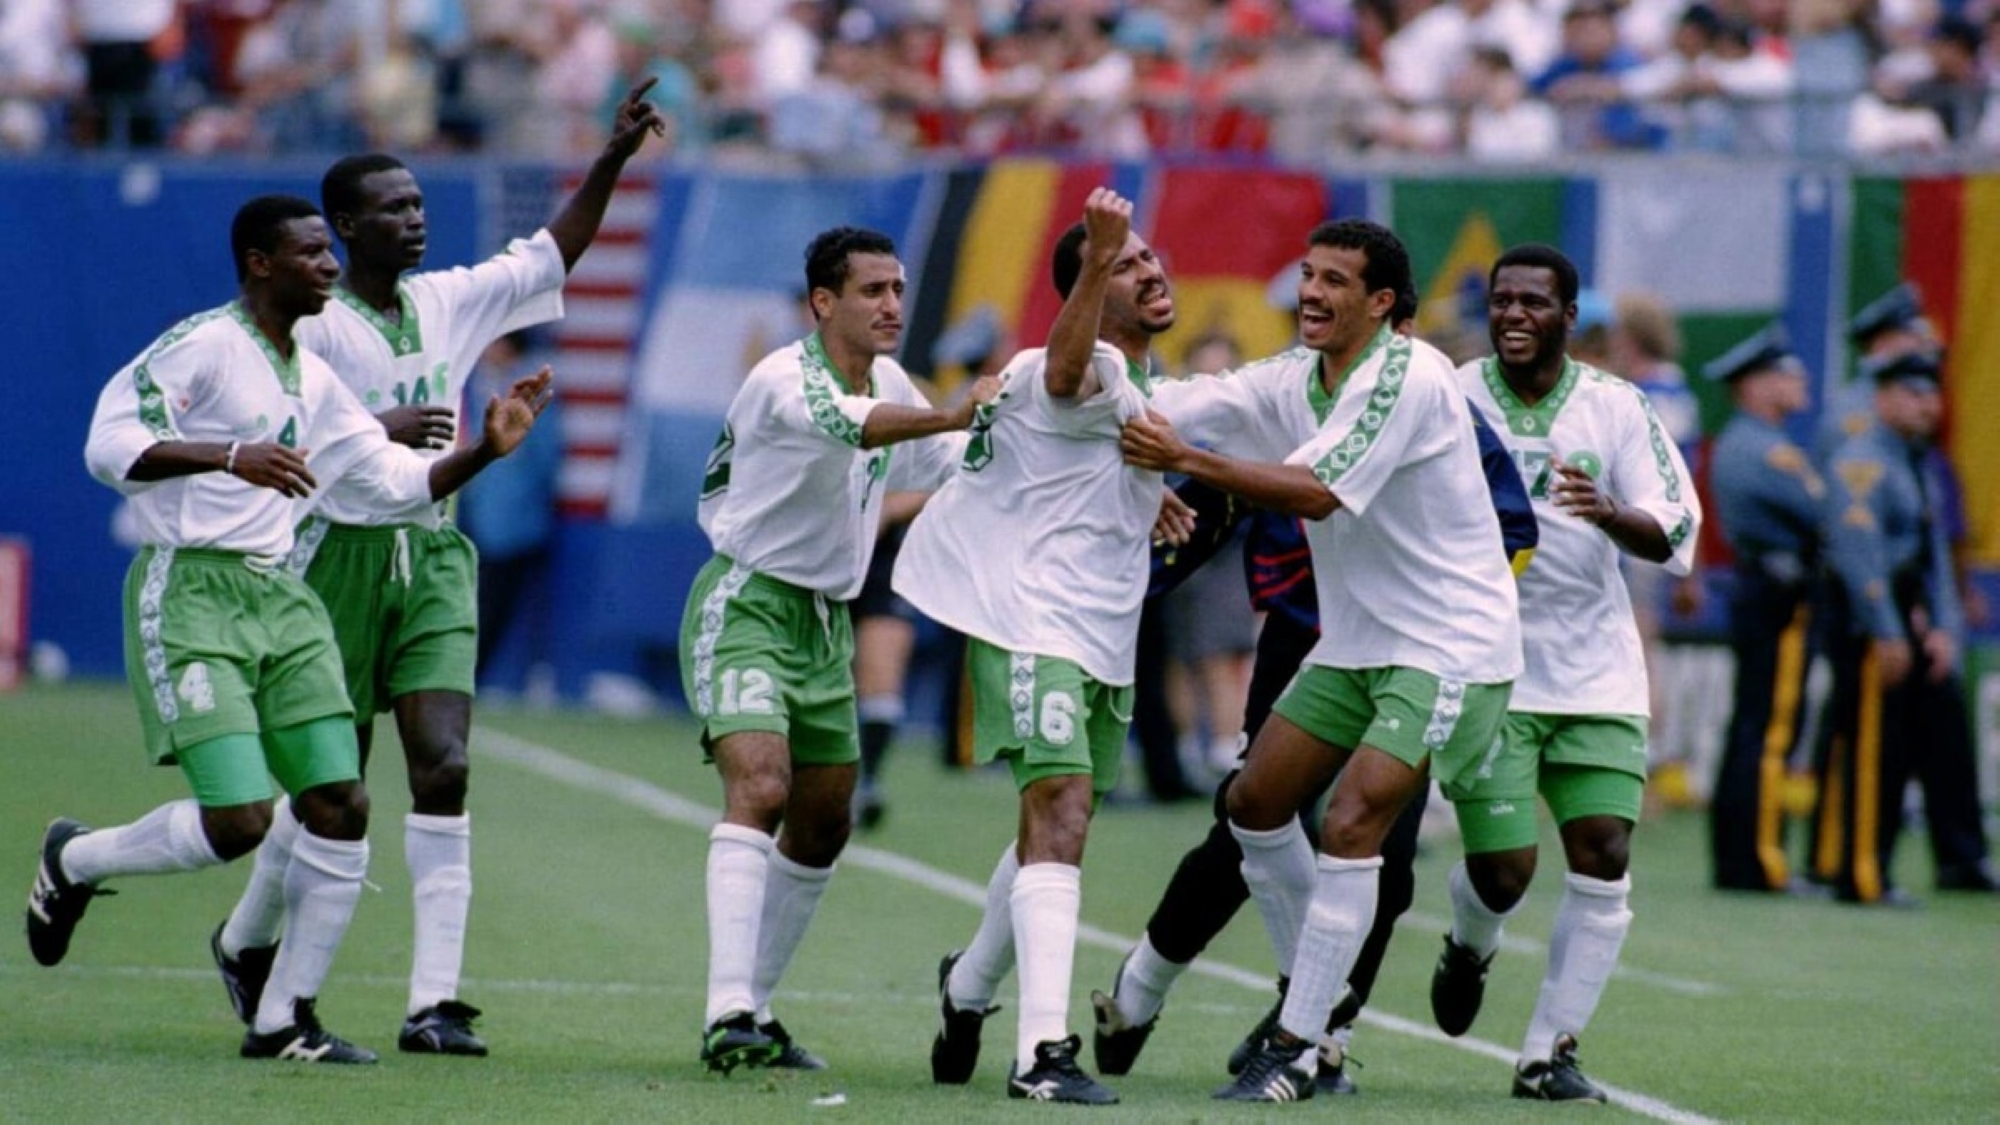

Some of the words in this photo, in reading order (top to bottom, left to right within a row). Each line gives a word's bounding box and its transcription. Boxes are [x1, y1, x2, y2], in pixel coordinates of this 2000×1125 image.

[178, 661, 215, 710] 4
[719, 668, 774, 715] 12
[1040, 690, 1075, 744] 6
